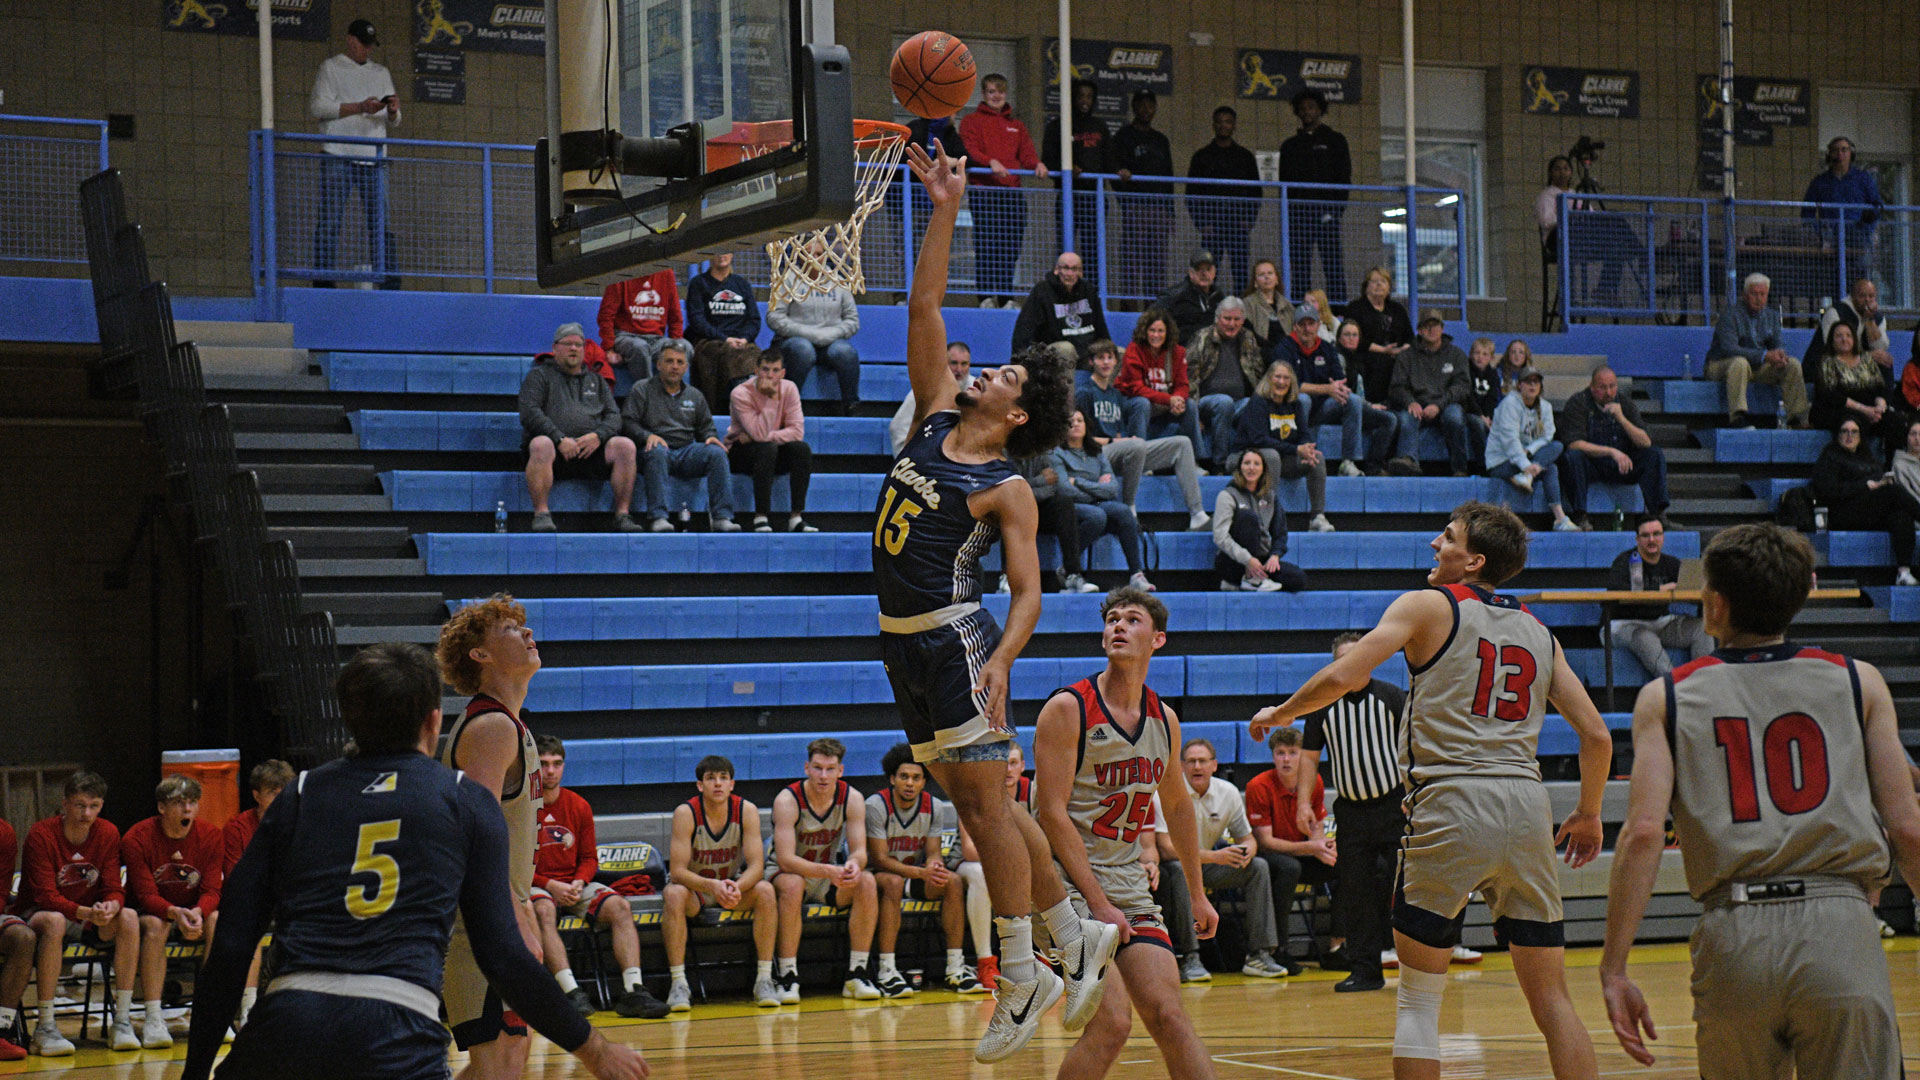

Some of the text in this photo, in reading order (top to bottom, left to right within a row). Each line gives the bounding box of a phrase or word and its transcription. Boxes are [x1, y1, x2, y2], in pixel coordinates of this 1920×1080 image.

[493, 7, 547, 24] CLARK
[478, 28, 546, 41] Men's Basket
[1110, 50, 1159, 66] CLARKE
[1099, 70, 1124, 80] Men's
[1302, 61, 1347, 76] CLARKE
[1583, 77, 1627, 92] CLARKE
[1756, 85, 1798, 100] CLARKE
[1605, 96, 1628, 107] Cross
[629, 305, 666, 316] VITERBO
[708, 301, 746, 312] VITERBO
[891, 457, 941, 510] Clarke
[875, 485, 924, 555] 15
[1471, 637, 1537, 722] 13
[1094, 757, 1165, 786] VITERBO
[1712, 711, 1830, 824] 10
[1091, 792, 1152, 843] 25
[597, 847, 649, 864] CLARKE
[345, 819, 401, 920] 5
[900, 901, 941, 912] RIDE
[719, 910, 754, 921] PRI
